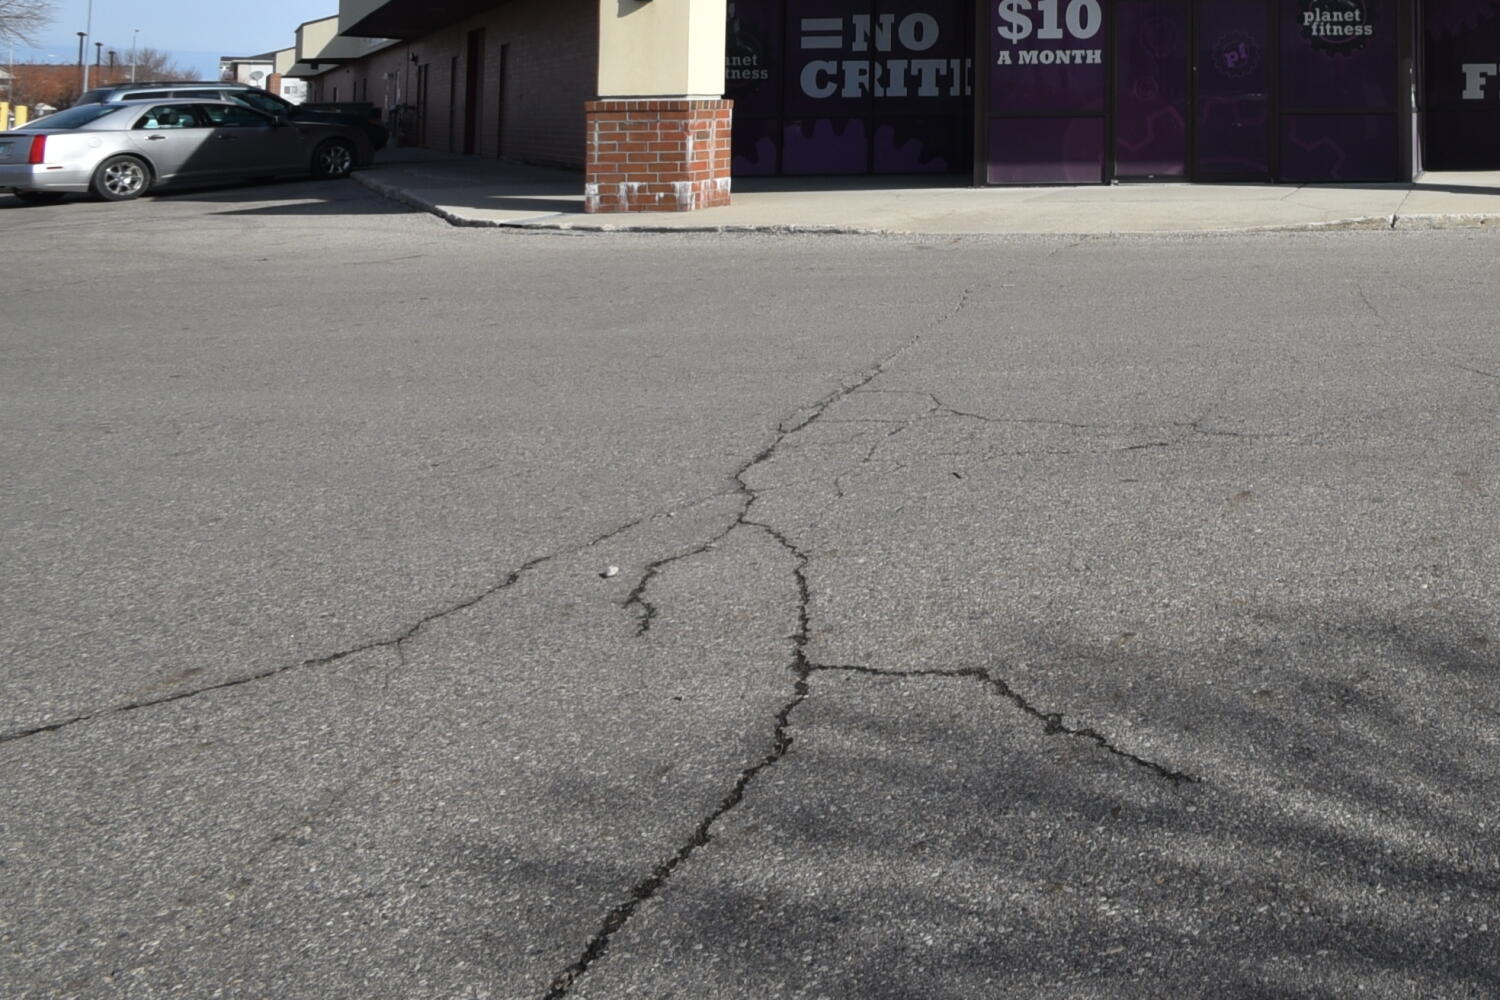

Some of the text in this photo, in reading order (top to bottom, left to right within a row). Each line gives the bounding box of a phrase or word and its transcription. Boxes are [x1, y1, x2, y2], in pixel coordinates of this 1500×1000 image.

[1303, 8, 1361, 25] planet
[852, 13, 940, 51] NO
[1311, 22, 1373, 36] fitness
[997, 49, 1102, 65] A MONTH
[725, 67, 769, 80] tness
[800, 58, 972, 99] CRITI
